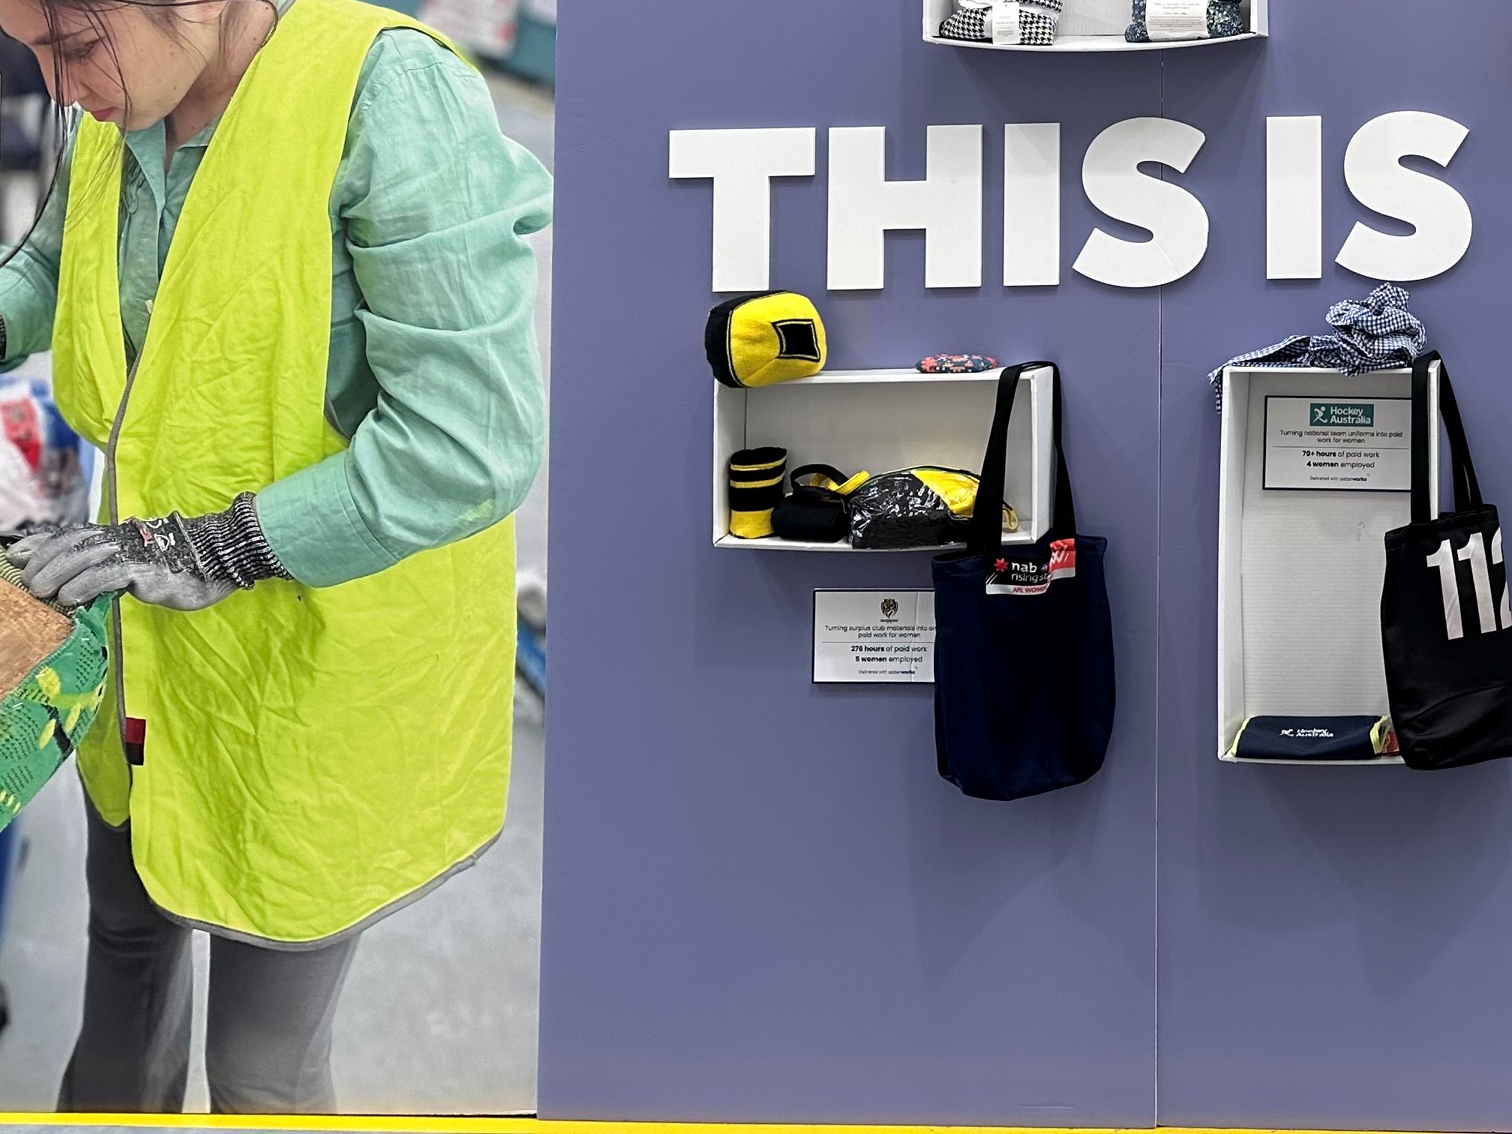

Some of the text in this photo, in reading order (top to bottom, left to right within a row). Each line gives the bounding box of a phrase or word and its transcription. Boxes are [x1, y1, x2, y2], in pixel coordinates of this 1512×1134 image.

[669, 116, 1208, 292] THIS
[1267, 110, 1474, 280] IS
[1331, 407, 1363, 416] Hockey
[1330, 415, 1371, 424] Australia
[1012, 563, 1037, 572] nab
[1012, 573, 1038, 583] rising
[889, 656, 922, 664] employed
